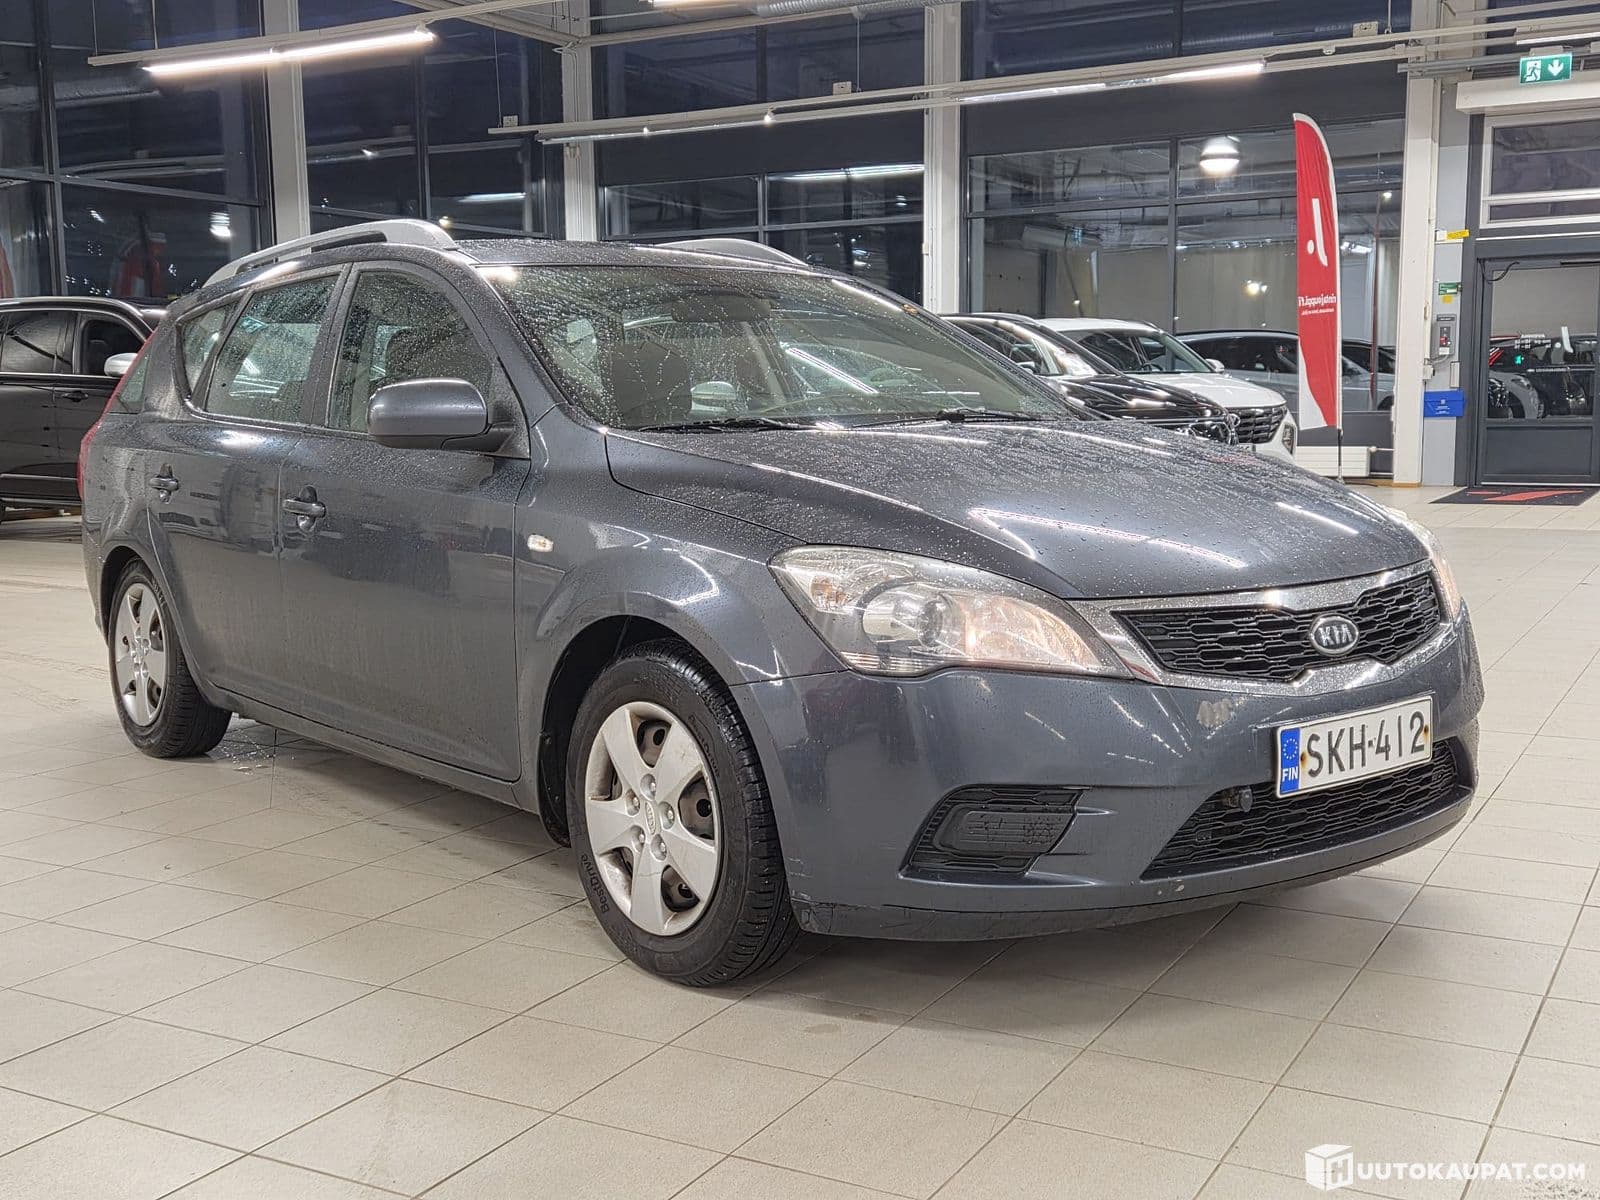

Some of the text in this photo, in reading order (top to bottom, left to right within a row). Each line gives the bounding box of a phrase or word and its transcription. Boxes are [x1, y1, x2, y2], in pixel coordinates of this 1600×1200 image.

[1319, 623, 1353, 647] KIA
[1306, 711, 1425, 778] SKH-412
[1282, 766, 1298, 782] FIN
